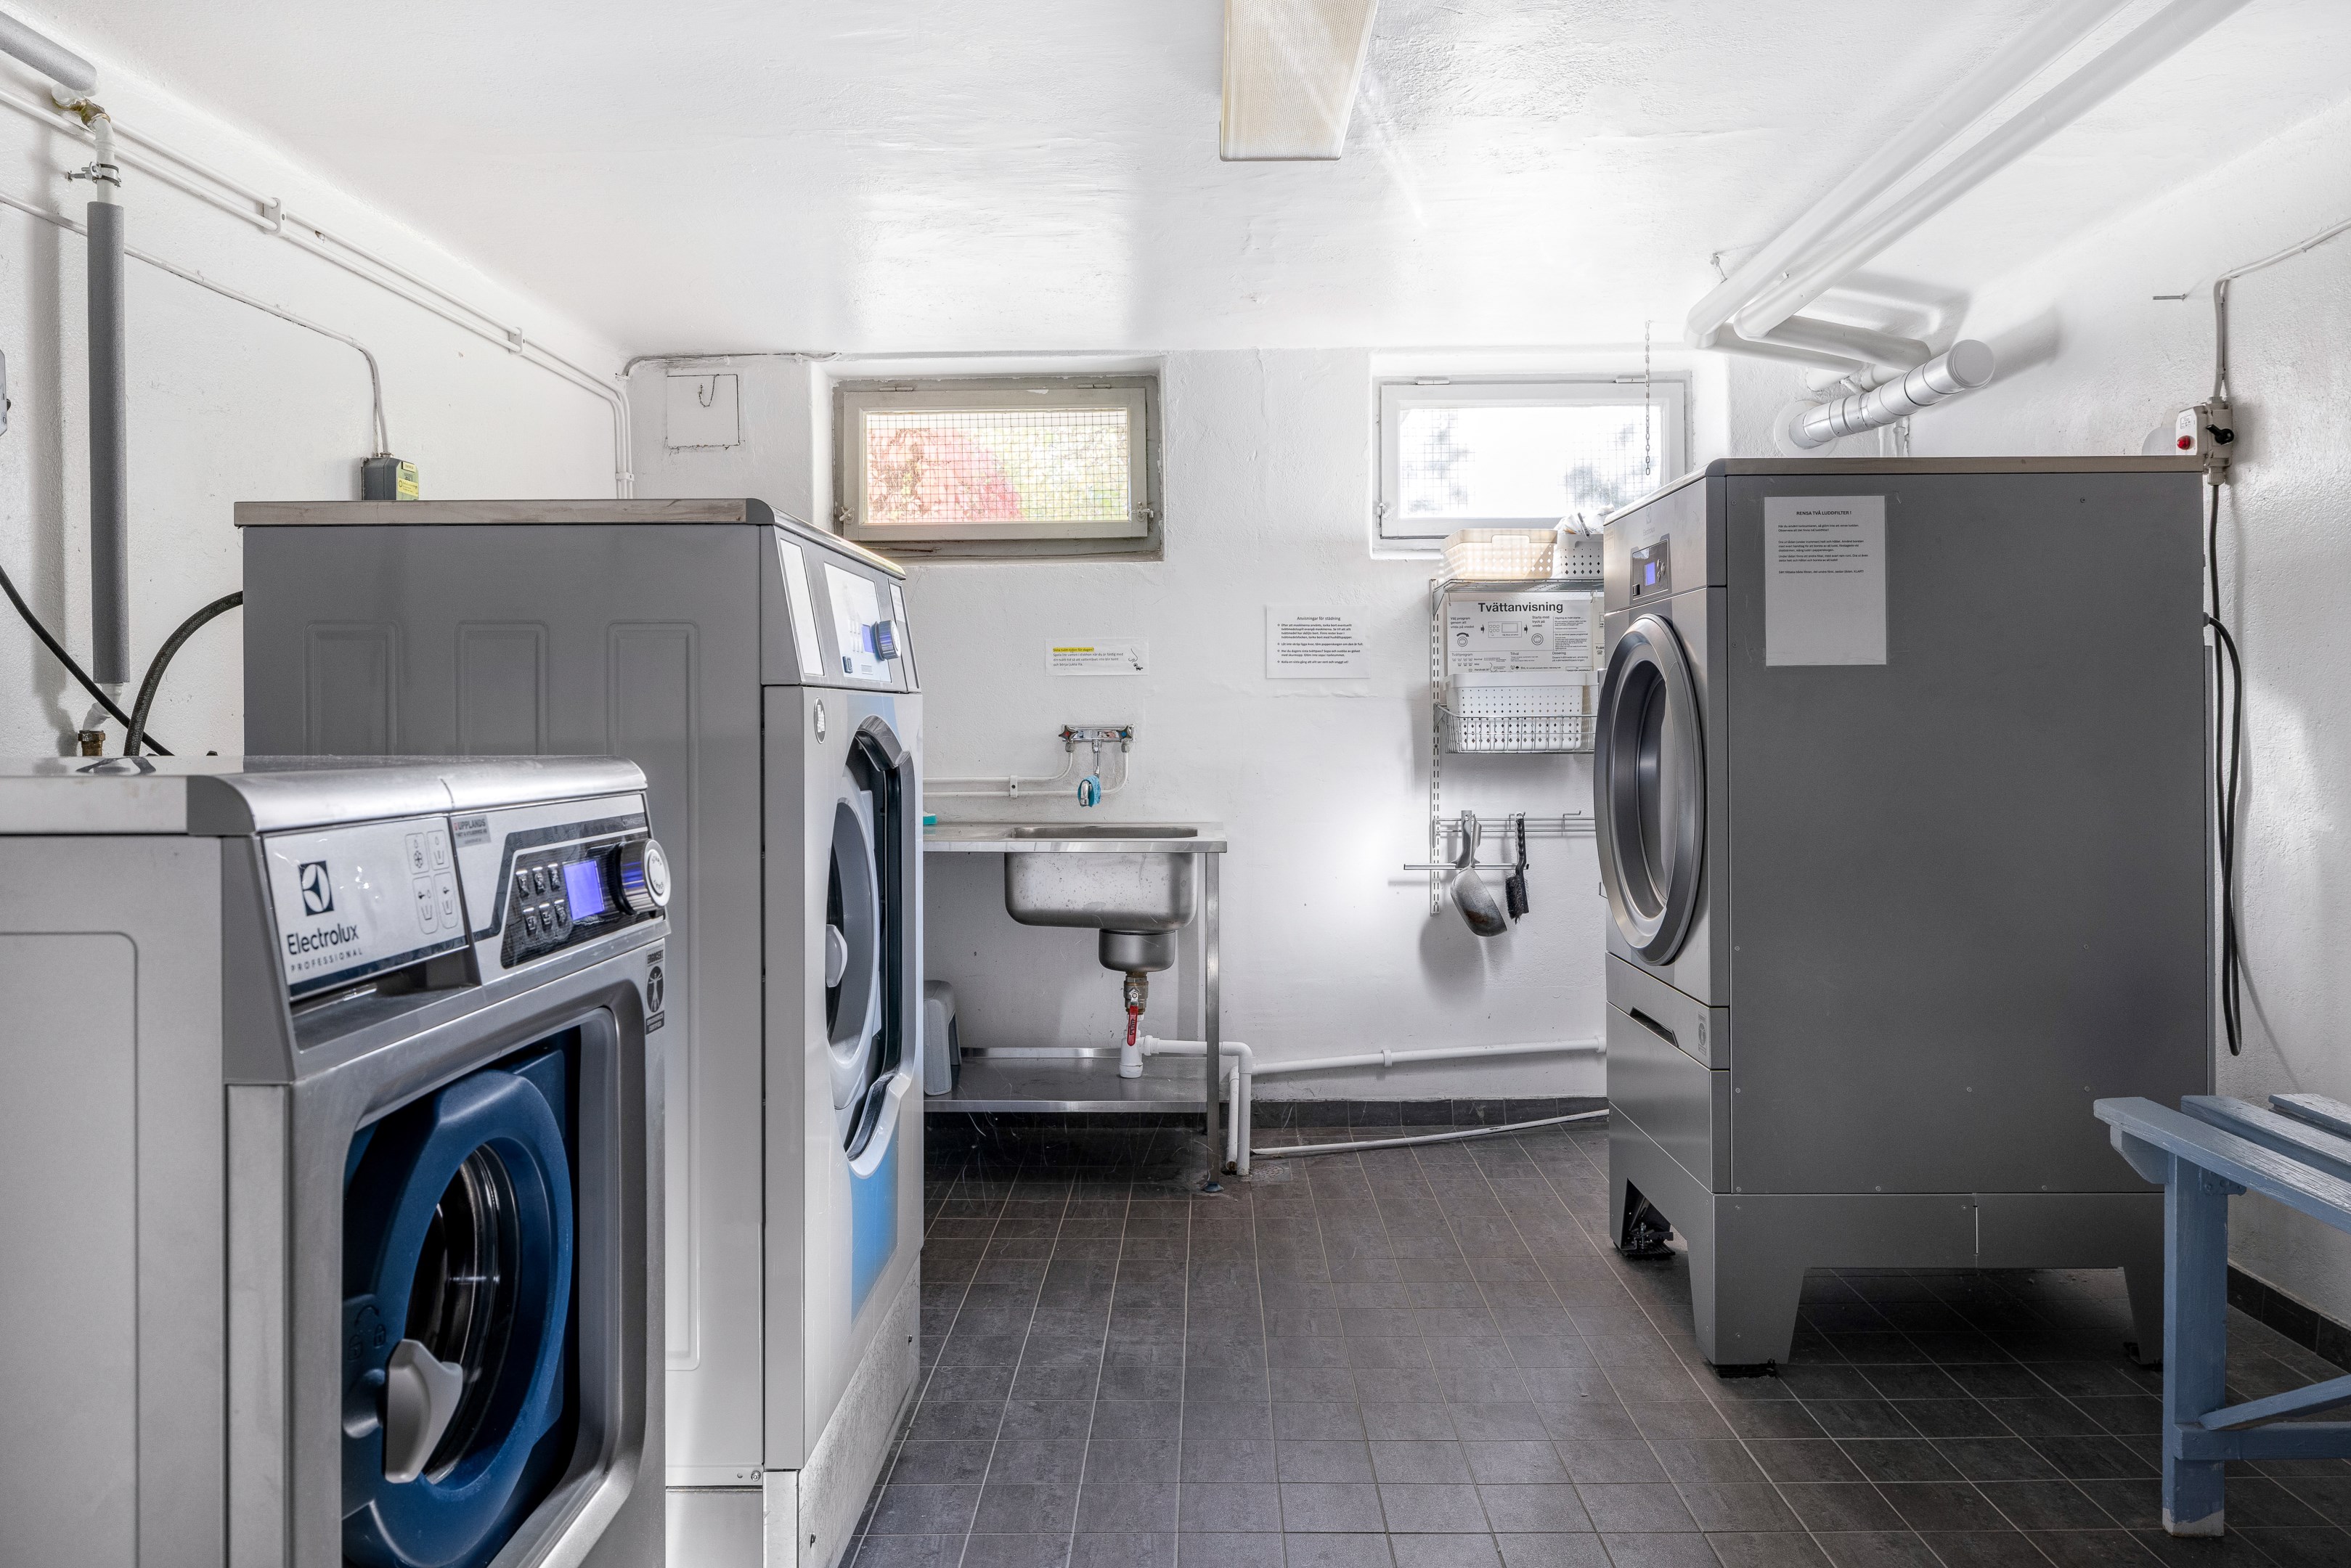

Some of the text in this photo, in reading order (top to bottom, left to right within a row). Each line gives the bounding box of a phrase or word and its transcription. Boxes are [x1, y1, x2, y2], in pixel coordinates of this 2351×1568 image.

[1478, 602, 1563, 613] Tvättanvisning
[286, 923, 360, 955] Electrolux
[291, 947, 362, 971] PROFESSIONAL
